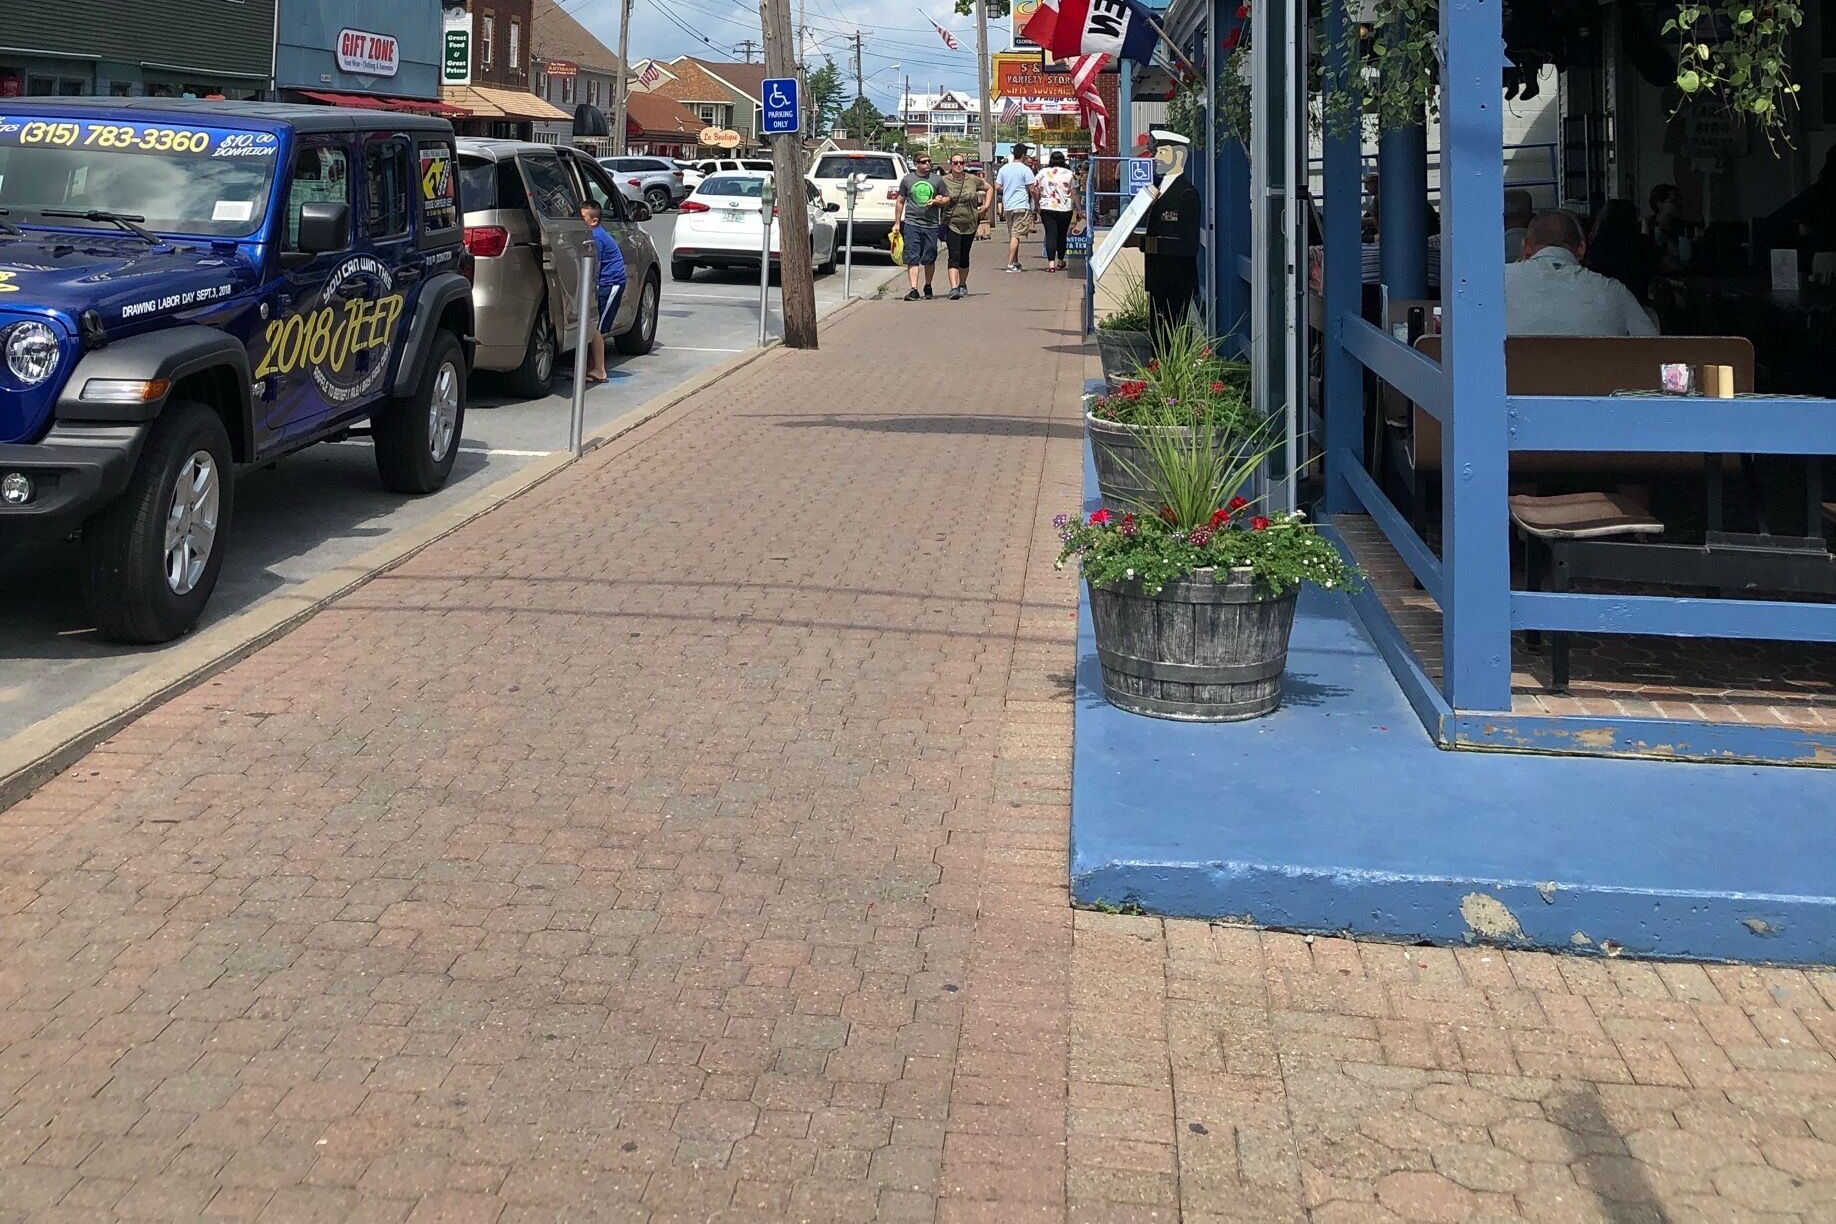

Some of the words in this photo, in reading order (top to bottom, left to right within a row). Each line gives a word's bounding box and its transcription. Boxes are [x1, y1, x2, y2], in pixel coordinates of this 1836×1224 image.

[342, 32, 366, 58] GIFT
[368, 38, 394, 62] ZONE
[1032, 63, 1040, 72] &
[1007, 75, 1043, 84] VARIETY
[768, 110, 793, 118] PARKING
[773, 120, 789, 128] ONLY
[19, 121, 80, 147] (315)
[84, 125, 210, 153] 783-3360
[211, 146, 277, 157] DONATION
[342, 258, 360, 278] CAN
[377, 263, 393, 291] THIS
[122, 300, 156, 318] DRAWING
[158, 295, 180, 310] LABOR
[182, 292, 195, 304] DAY
[218, 284, 231, 296] 2018
[255, 307, 334, 380] 2018
[330, 293, 404, 373] JEEP
